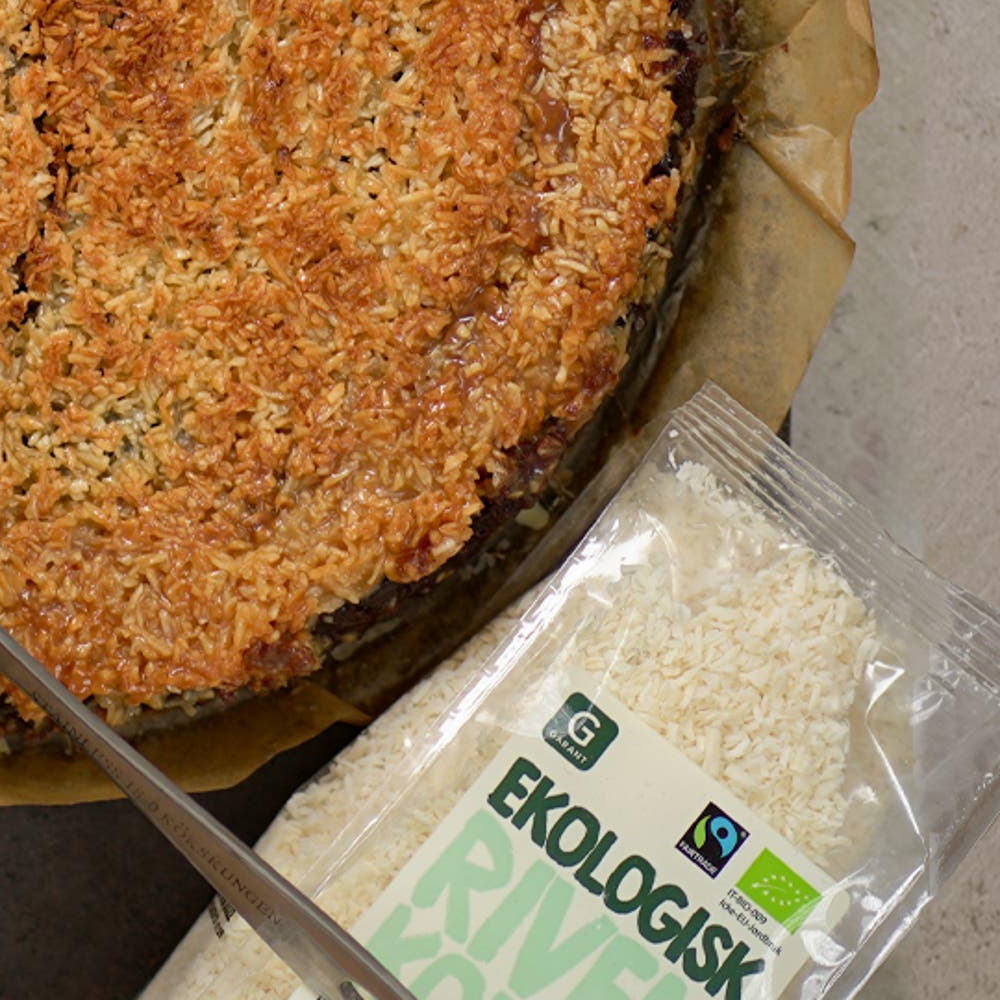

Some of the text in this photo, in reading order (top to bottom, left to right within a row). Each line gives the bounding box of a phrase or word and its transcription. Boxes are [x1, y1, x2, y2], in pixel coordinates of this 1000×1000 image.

[550, 729, 588, 764] GARANT
[679, 840, 718, 875] FAIRTRADE
[487, 756, 765, 1000] EKOLOGISK
